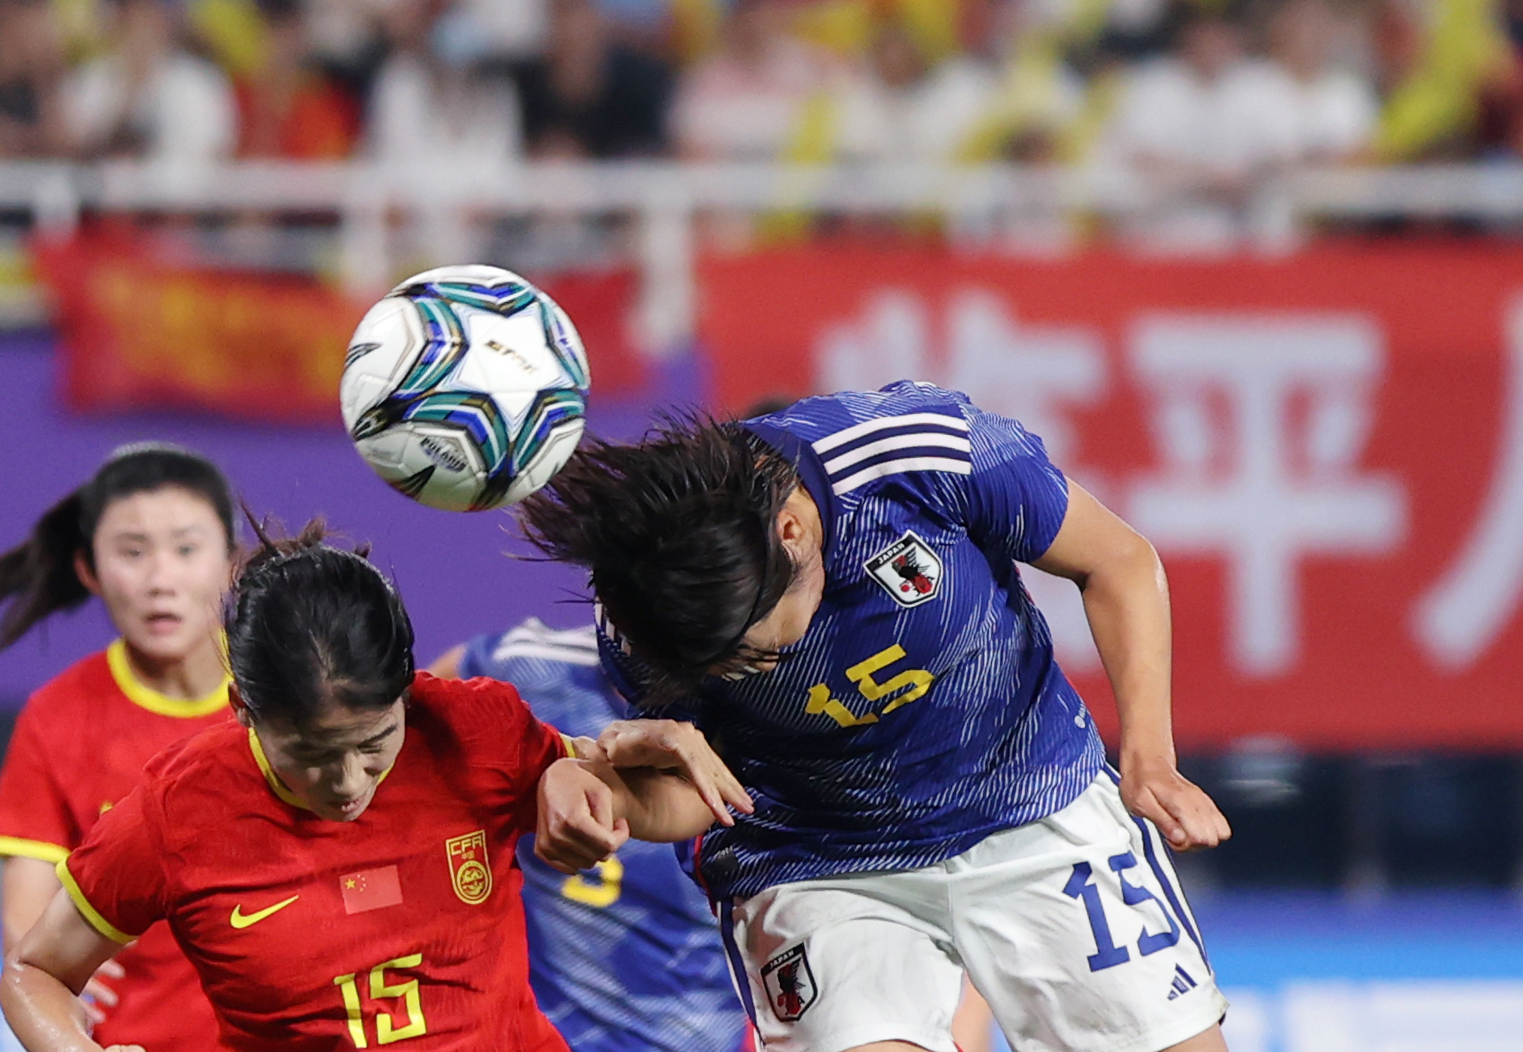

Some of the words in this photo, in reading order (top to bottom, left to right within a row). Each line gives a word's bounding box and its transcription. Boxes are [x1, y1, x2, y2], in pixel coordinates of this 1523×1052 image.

[877, 542, 906, 565] JAPAN
[804, 643, 935, 728] 15
[450, 835, 483, 856] CFA
[1062, 849, 1181, 973] 15
[769, 949, 795, 969] JAPAN
[333, 953, 427, 1049] 15
